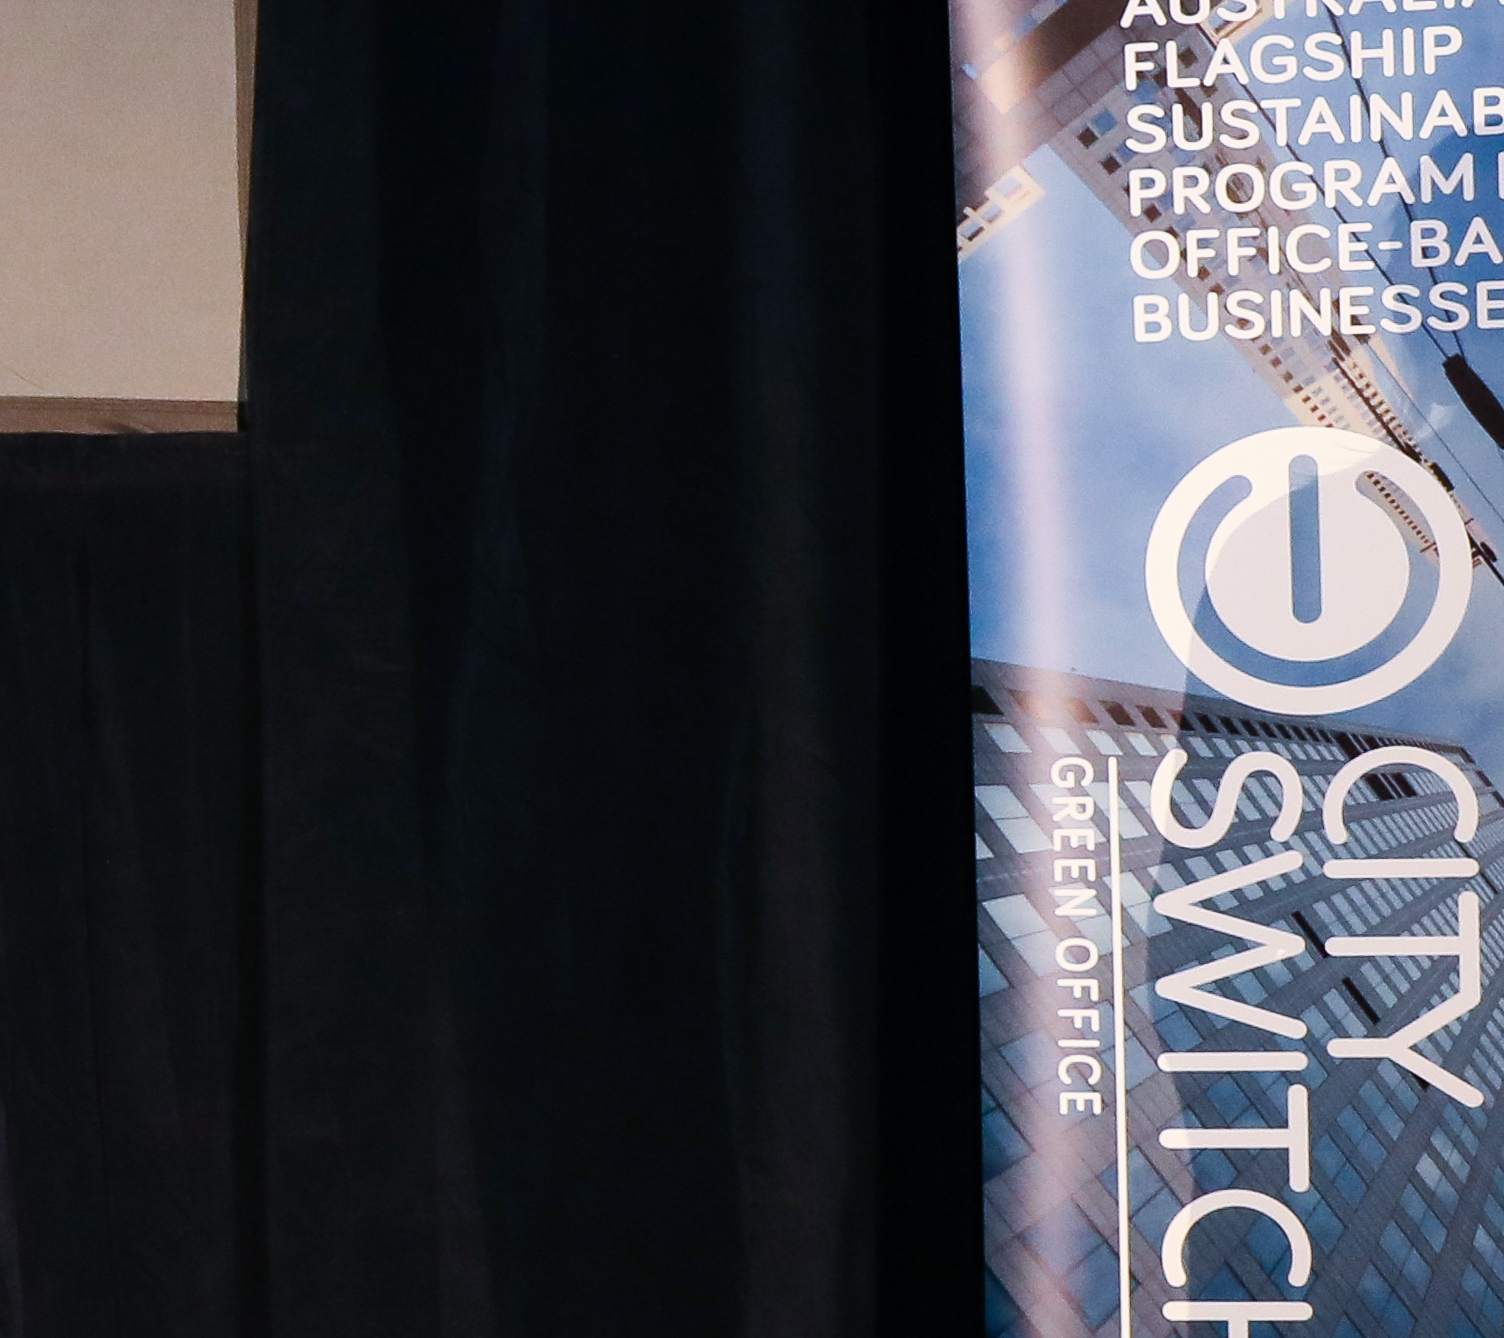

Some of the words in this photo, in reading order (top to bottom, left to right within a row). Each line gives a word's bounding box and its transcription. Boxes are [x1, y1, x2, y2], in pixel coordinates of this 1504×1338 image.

[1123, 24, 1464, 90] FLAGSHIP
[1125, 87, 1504, 154] SUSTAINAB
[1127, 152, 1476, 218] PROGRAM
[1129, 216, 1504, 280] OFFICE-BA
[1133, 279, 1504, 343] BUSINESSE
[1050, 756, 1098, 916] GREEN
[1322, 744, 1486, 1108] CITY
[1054, 937, 1102, 1115] OFFICE
